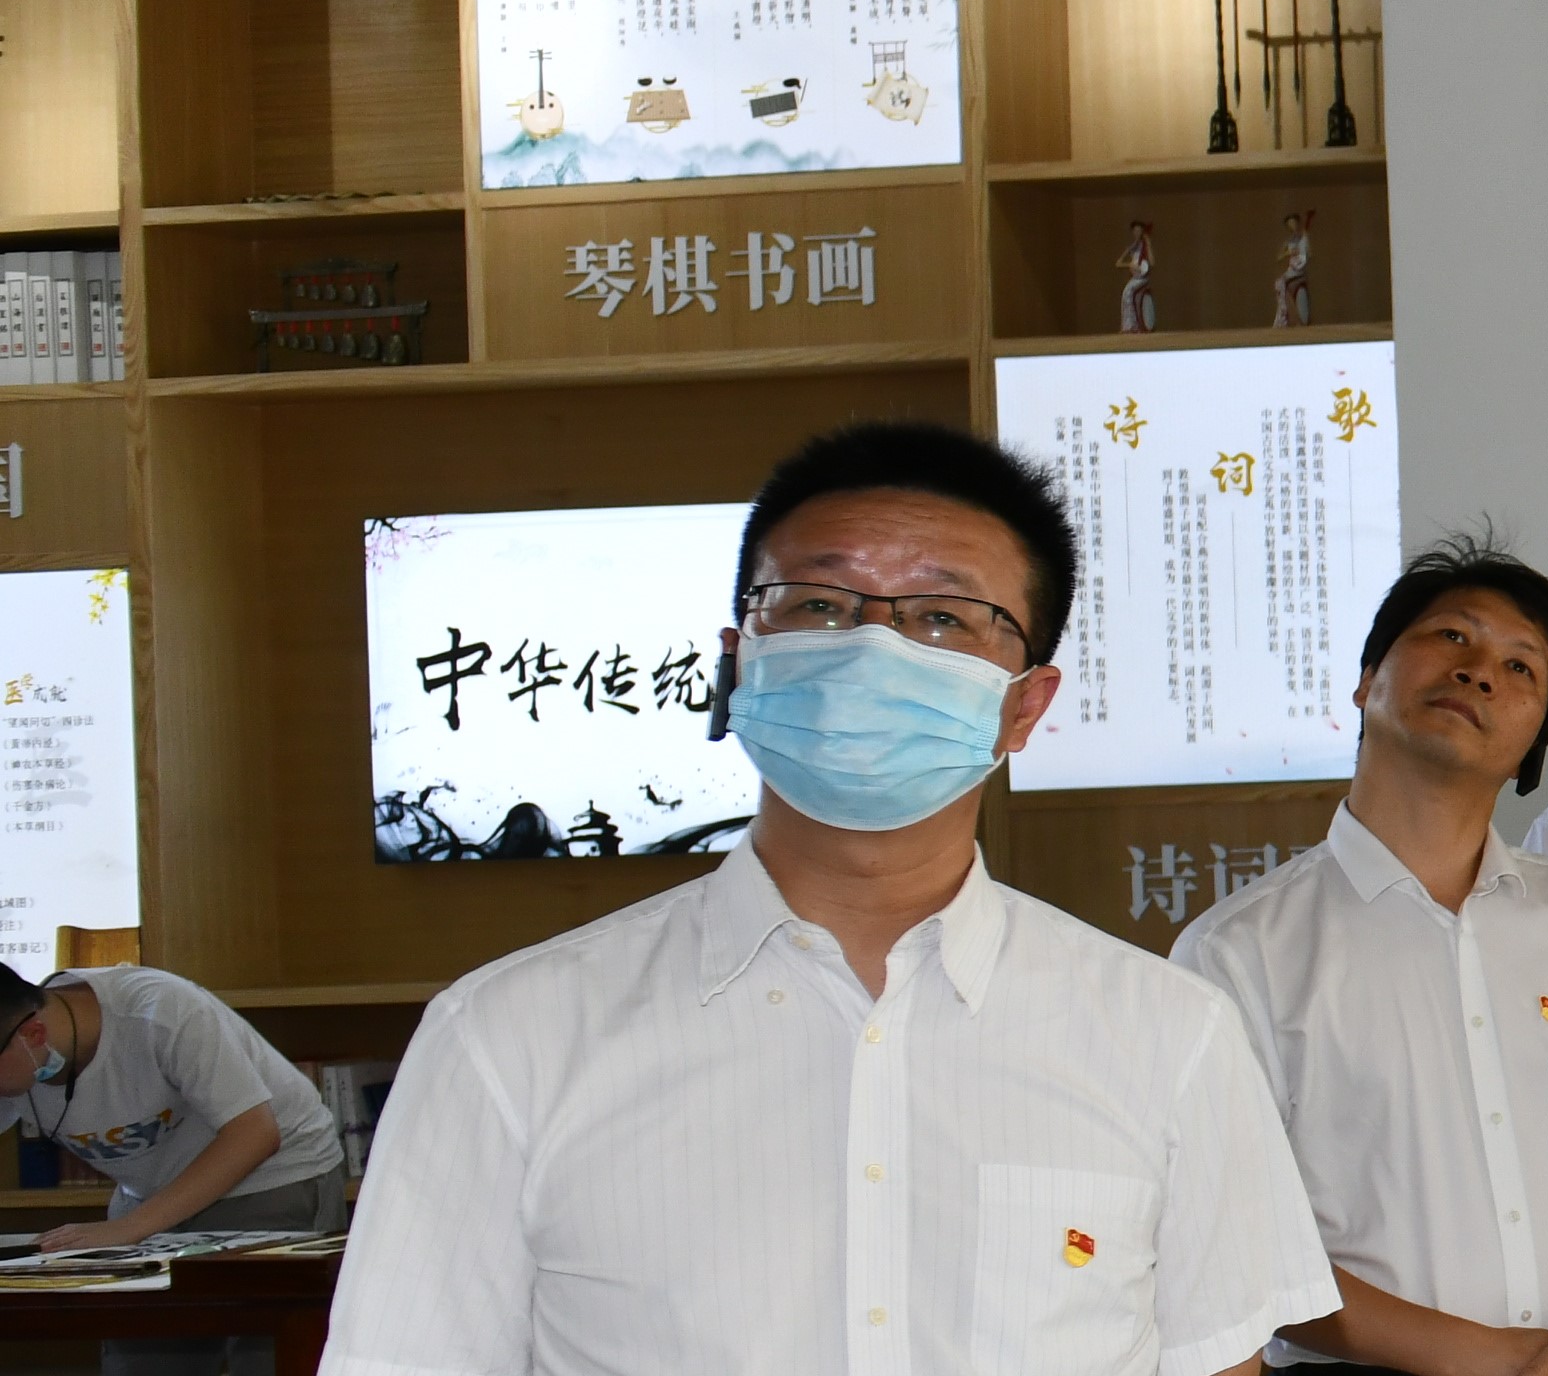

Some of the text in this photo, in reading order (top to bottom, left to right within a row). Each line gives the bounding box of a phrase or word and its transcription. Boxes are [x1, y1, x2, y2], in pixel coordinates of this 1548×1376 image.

[564, 226, 877, 318] 琴棋书画
[1104, 397, 1148, 448] 诗
[1327, 387, 1377, 442] 歌
[1210, 451, 1255, 496] 词
[416, 627, 713, 731] 中华传统
[1122, 842, 1318, 924] 诗词
